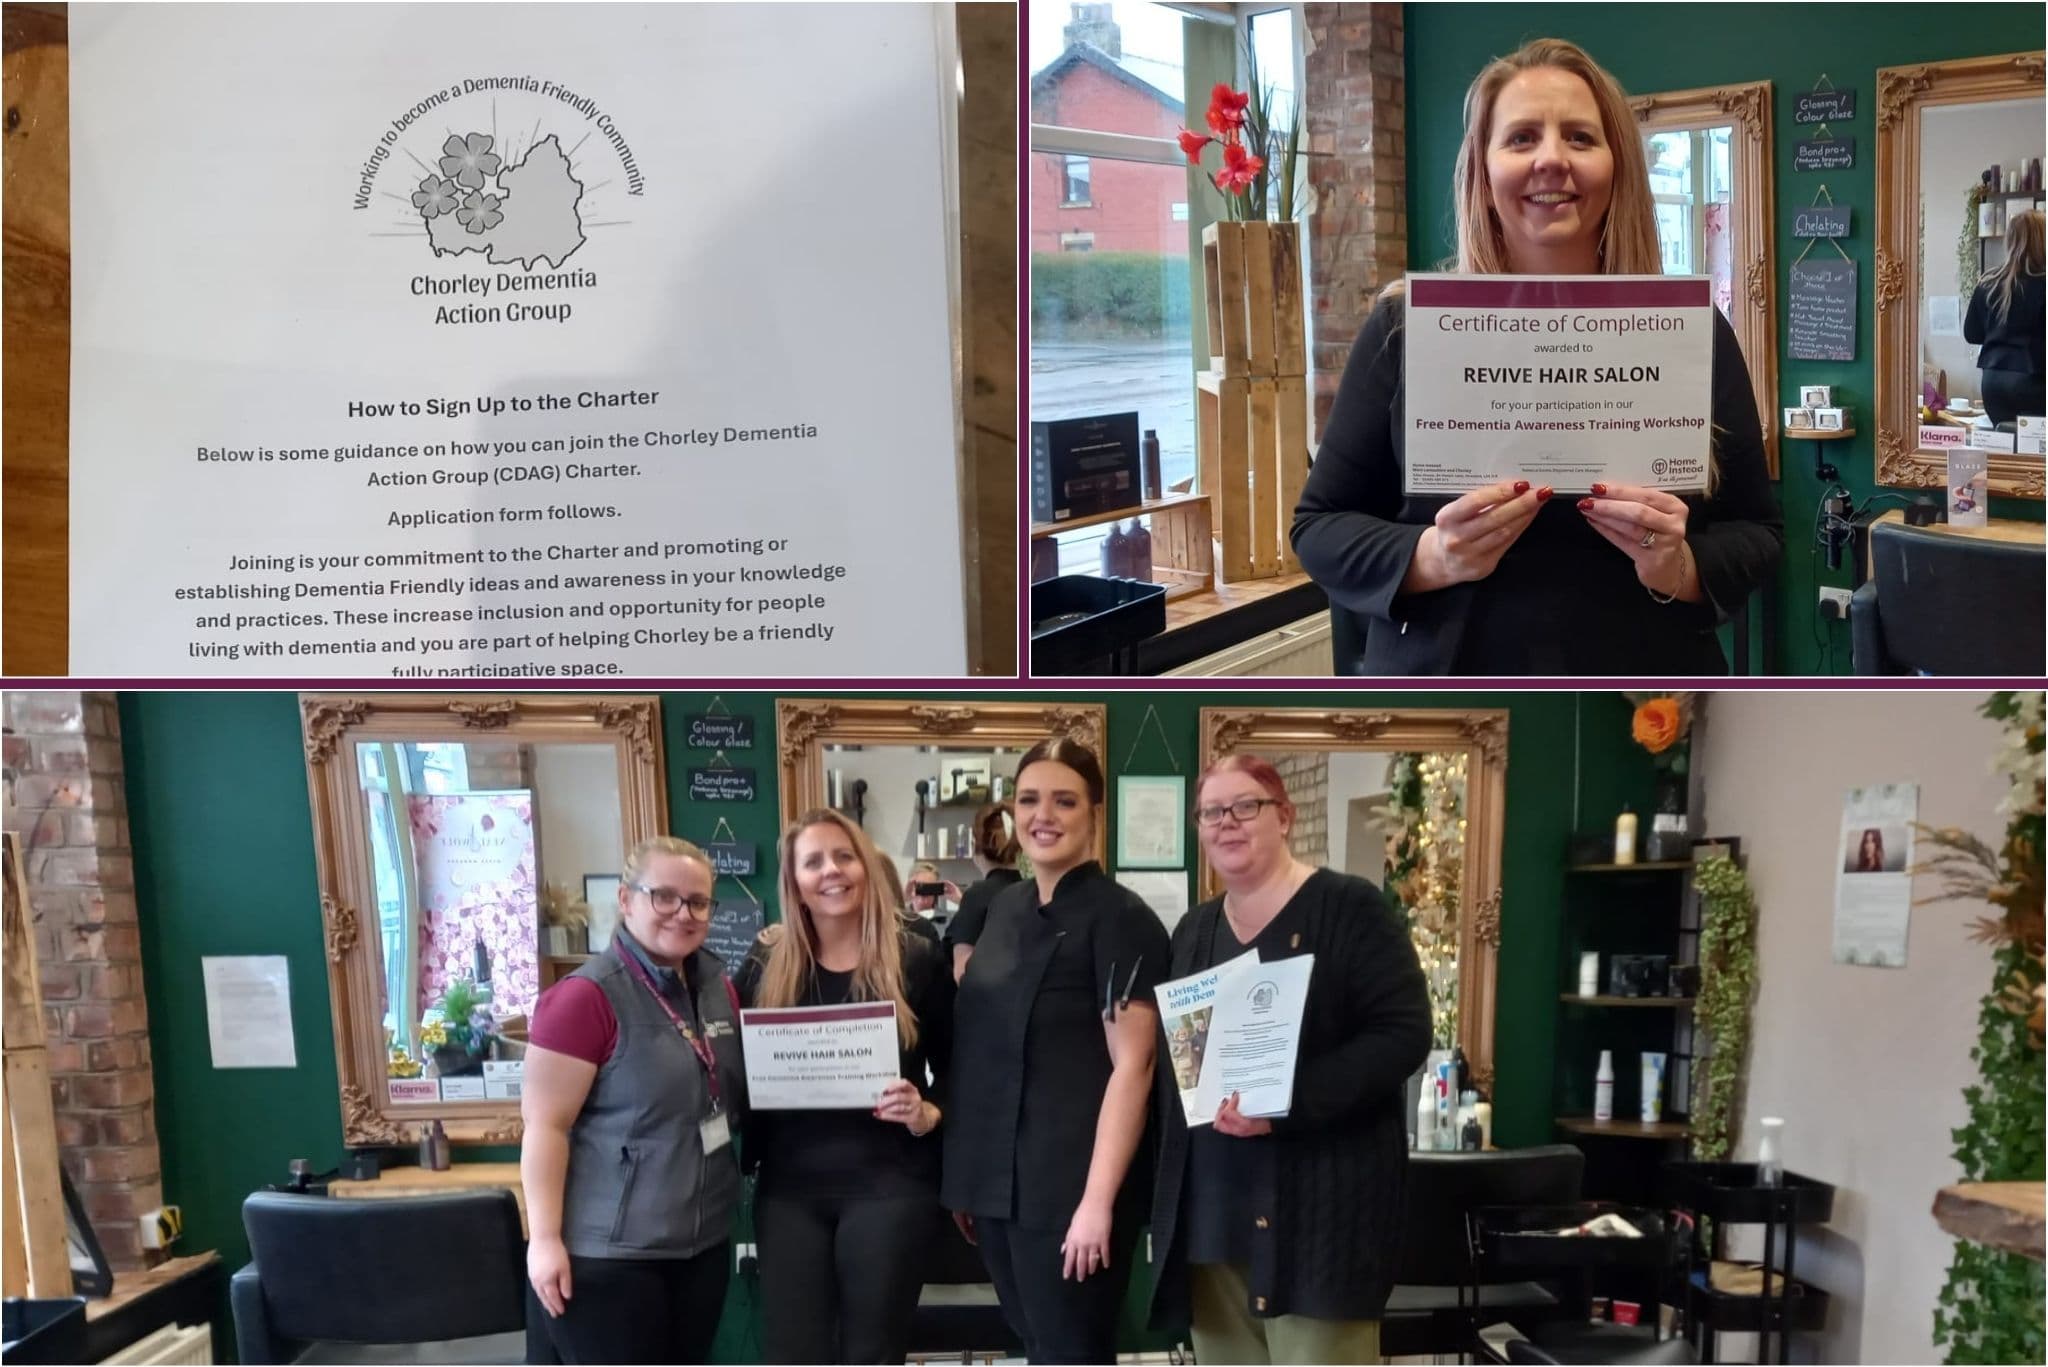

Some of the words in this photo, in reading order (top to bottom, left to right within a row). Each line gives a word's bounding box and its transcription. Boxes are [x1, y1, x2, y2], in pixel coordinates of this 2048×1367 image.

[1796, 112, 1826, 122] Colour
[353, 145, 390, 210] Working
[381, 130, 398, 146] to
[391, 90, 450, 132] become
[451, 85, 462, 98] a
[463, 75, 539, 93] Dementia
[541, 80, 600, 121] Friendly
[596, 114, 645, 196] Community
[1799, 145, 1824, 157] Bond
[1795, 214, 1845, 234] Chelating
[410, 273, 491, 297] Chorley
[497, 268, 597, 292] Dementia
[435, 303, 501, 324] Action
[506, 302, 572, 323] Group
[1438, 313, 1541, 333] Certificate
[1546, 314, 1568, 333] of
[1573, 314, 1685, 336] Completion
[1533, 342, 1579, 354] awarded
[1581, 343, 1594, 353] to
[1463, 366, 1534, 384] REVIVE
[1539, 367, 1589, 384] HAIR
[1593, 366, 1661, 383] SALON
[348, 400, 394, 417] How
[400, 400, 420, 415] to
[426, 397, 471, 417] Sign
[477, 396, 506, 416] Up
[510, 395, 532, 412] to
[537, 393, 572, 410] the
[577, 388, 660, 408] Charter
[1490, 399, 1507, 411] for
[1508, 401, 1534, 413] your
[1535, 398, 1602, 414] participation
[1603, 398, 1614, 411] in
[1615, 400, 1634, 410] our
[1416, 418, 1445, 430] Free
[1447, 418, 1512, 432] Dementia
[1514, 418, 1586, 431] Awareness
[1588, 418, 1641, 432] Training
[1643, 416, 1706, 430] Workshop
[197, 447, 254, 462] Below
[258, 446, 274, 461] is
[279, 446, 330, 460] some
[334, 443, 419, 462] guidance
[423, 444, 446, 457] on
[450, 441, 489, 456] how
[493, 440, 527, 457] you
[531, 438, 565, 453] can
[569, 435, 604, 454] join
[608, 432, 640, 449] the
[644, 429, 720, 448] Chorley
[724, 424, 818, 443] Dementia
[1920, 430, 1962, 443] Klarna.
[1668, 457, 1697, 467] Home
[1668, 464, 1704, 475] Instead
[367, 471, 428, 487] Action
[432, 469, 489, 486] Group
[493, 464, 561, 484] (CDAG)
[565, 462, 642, 480] Charter.
[387, 508, 495, 529] Application
[498, 506, 543, 522] form
[547, 504, 623, 521] follows.
[229, 555, 295, 573] Joining
[299, 554, 314, 569] is
[318, 556, 360, 572] your
[364, 549, 484, 567] commitment
[489, 549, 507, 562] to
[511, 546, 543, 562] the
[547, 542, 619, 561] Charter
[623, 541, 659, 558] and
[664, 538, 764, 559] promoting
[768, 538, 789, 552] or
[174, 583, 291, 602] establishing
[295, 581, 385, 599] Dementia
[390, 578, 465, 596] Friendly
[469, 576, 520, 592] ideas
[524, 575, 559, 591] and
[564, 571, 667, 589] awareness
[671, 570, 688, 586] in
[693, 568, 736, 587] your
[740, 563, 847, 585] knowledge
[195, 613, 231, 628] and
[236, 612, 329, 631] practices.
[333, 609, 389, 625] These
[393, 607, 473, 623] increase
[477, 603, 564, 621] inclusion
[569, 602, 604, 618] and
[609, 597, 722, 619] opportunity
[726, 596, 754, 613] for
[758, 593, 826, 614] people
[189, 641, 240, 660] living
[243, 640, 284, 656] with
[288, 638, 377, 655] dementia
[381, 637, 416, 653] and
[420, 638, 454, 654] you
[458, 636, 489, 650] are
[493, 634, 531, 653] part
[535, 632, 555, 648] of
[559, 630, 630, 649] helping
[634, 627, 710, 646] Chorley
[714, 626, 739, 642] be
[743, 629, 754, 641] a
[758, 622, 835, 642] friendly
[392, 665, 433, 676] fully
[438, 662, 556, 676] participative
[561, 662, 624, 676] space.
[688, 734, 720, 747] Colour
[694, 772, 721, 785] Bond
[705, 849, 750, 874] helating
[1167, 984, 1199, 999] Living
[1169, 995, 1191, 1009] with
[1192, 989, 1215, 1002] Dem
[758, 1026, 811, 1037] Certificate
[813, 1025, 823, 1036] of
[825, 1022, 883, 1036] Completion
[773, 1050, 808, 1061] REVIVE
[810, 1049, 835, 1060] HAIR
[838, 1047, 873, 1058] SALON
